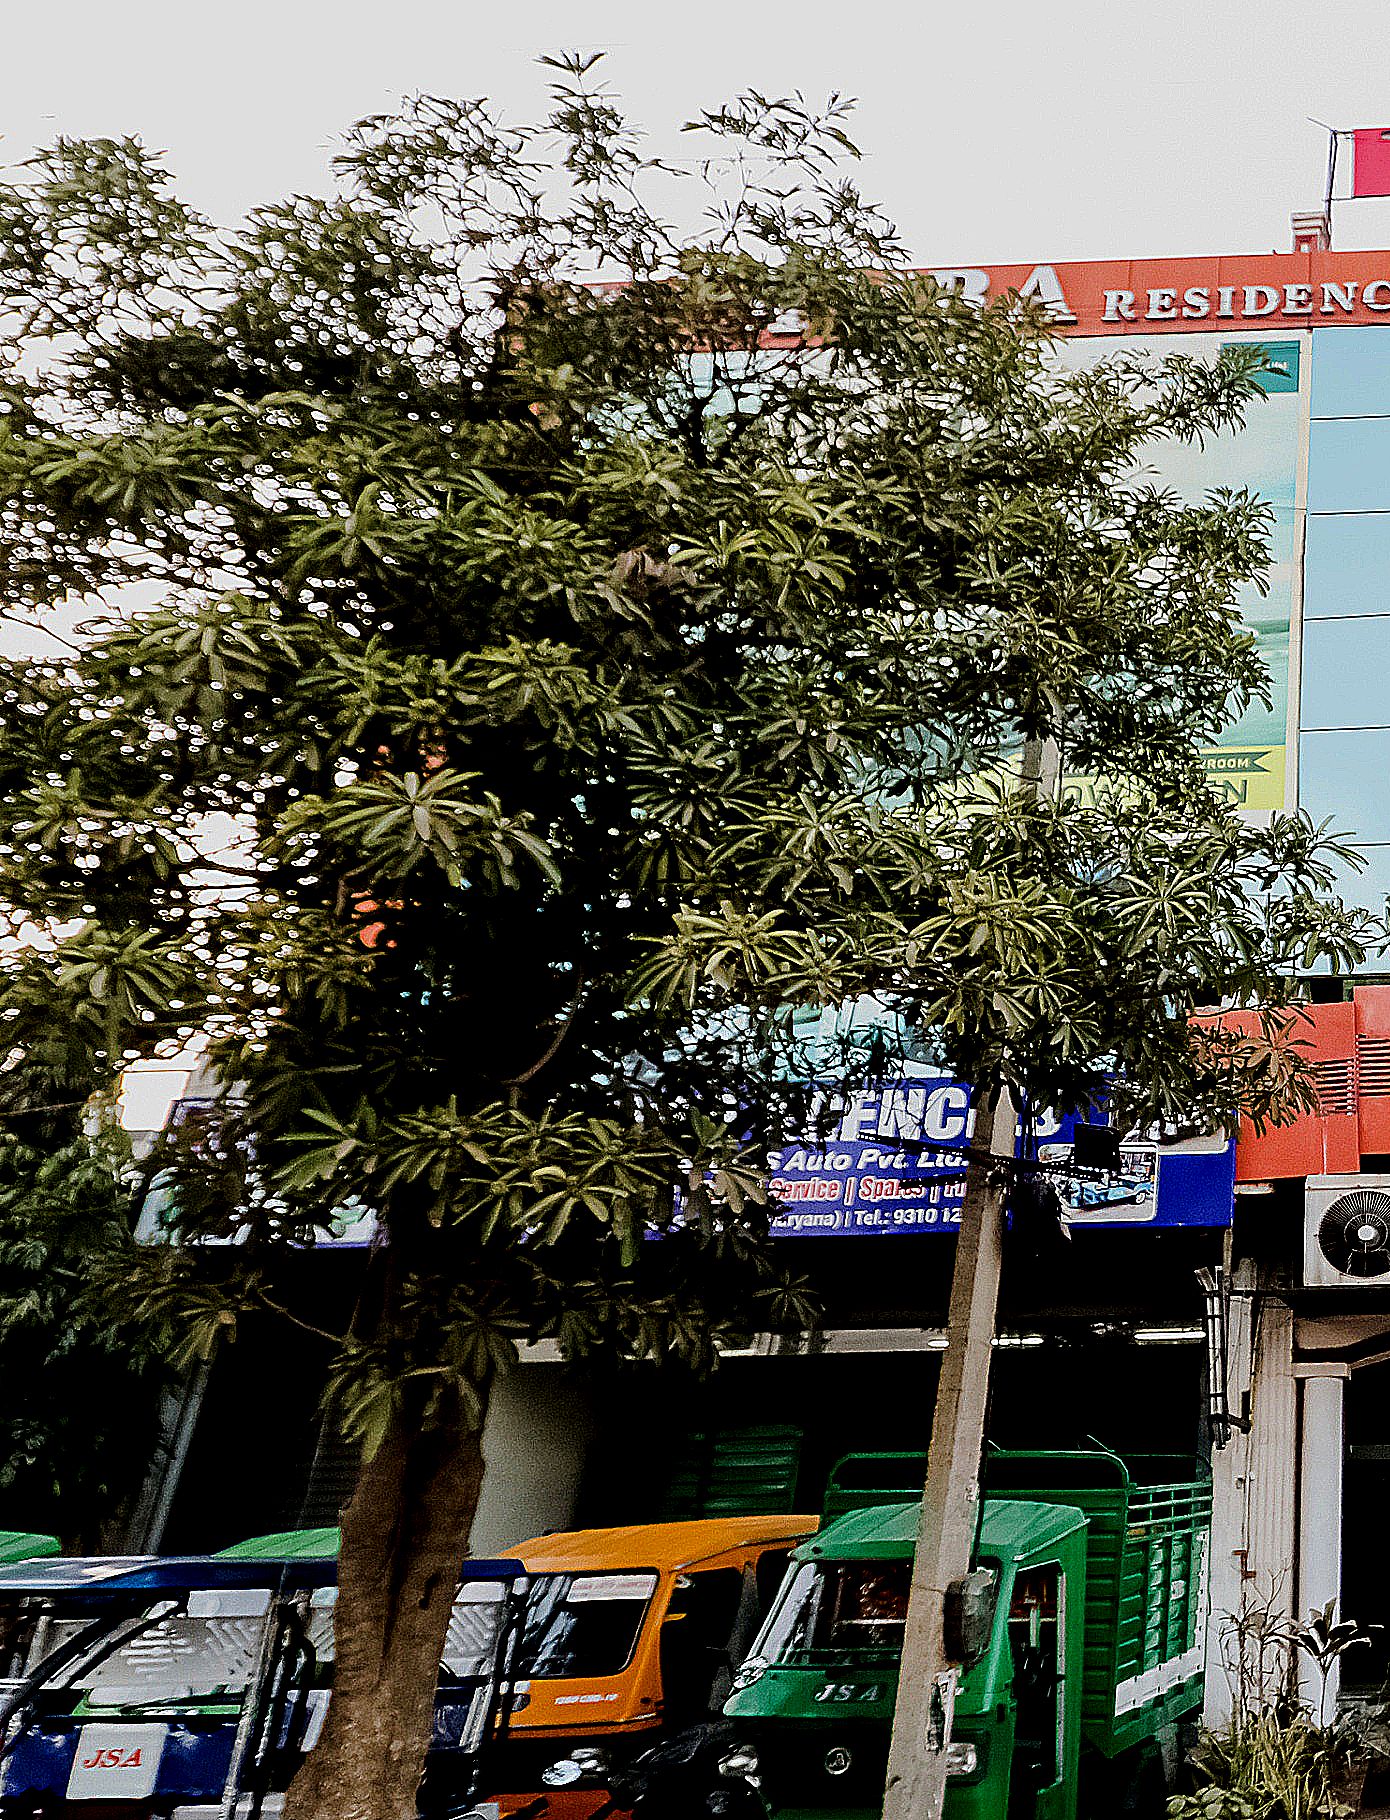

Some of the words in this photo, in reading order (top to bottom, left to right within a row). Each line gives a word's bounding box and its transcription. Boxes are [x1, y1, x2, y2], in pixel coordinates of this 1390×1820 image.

[782, 1151, 850, 1171] Auto
[768, 1178, 840, 1201] Service
[894, 1208, 938, 1225] 9310
[814, 1684, 880, 1702] JSA
[84, 1748, 142, 1768] JSA
